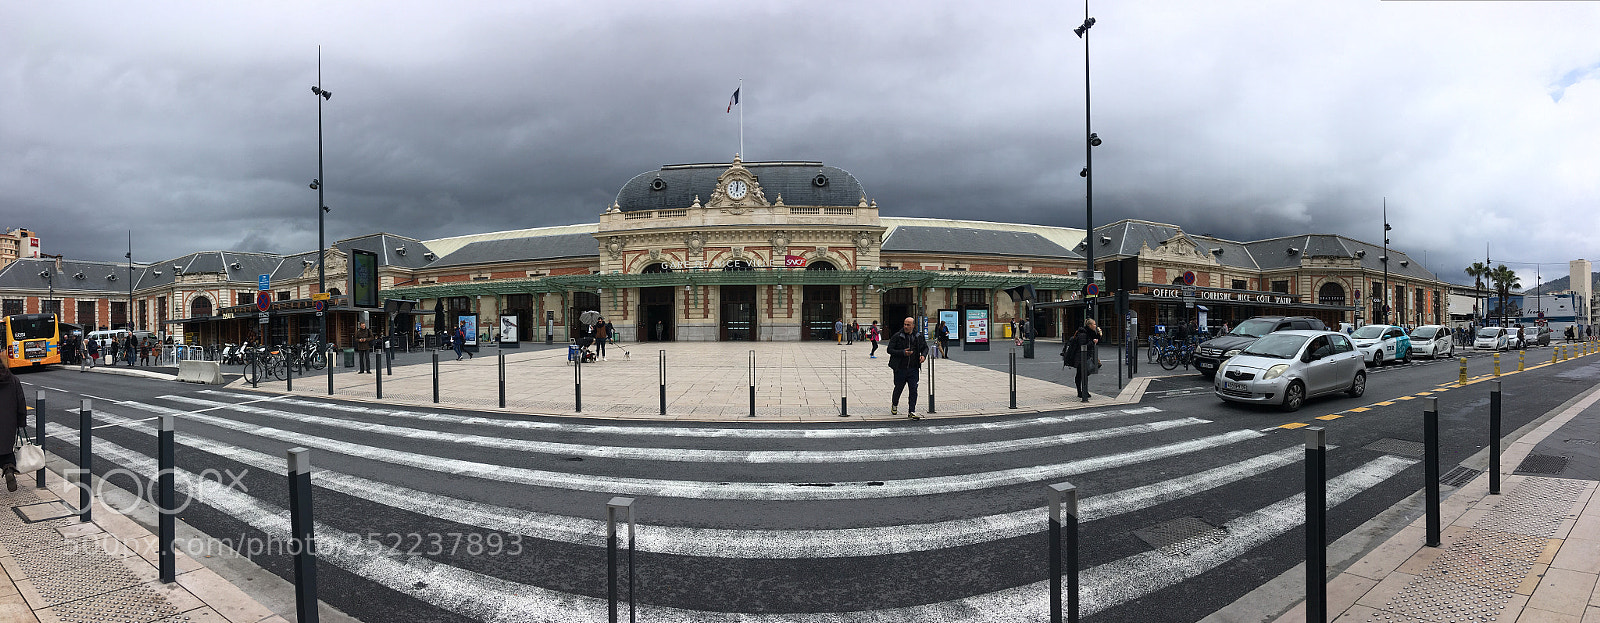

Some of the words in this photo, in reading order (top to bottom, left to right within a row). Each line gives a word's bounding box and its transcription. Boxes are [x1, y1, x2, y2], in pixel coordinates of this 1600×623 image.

[661, 259, 690, 270] GARE
[695, 259, 709, 269] DE
[713, 259, 741, 269] NICE
[746, 258, 774, 268] VILLE
[785, 258, 806, 267] SNCF
[1153, 288, 1179, 299] OFFICE
[1201, 291, 1231, 302] TOURISME
[1237, 294, 1250, 302] NICE
[222, 312, 236, 320] PAUL
